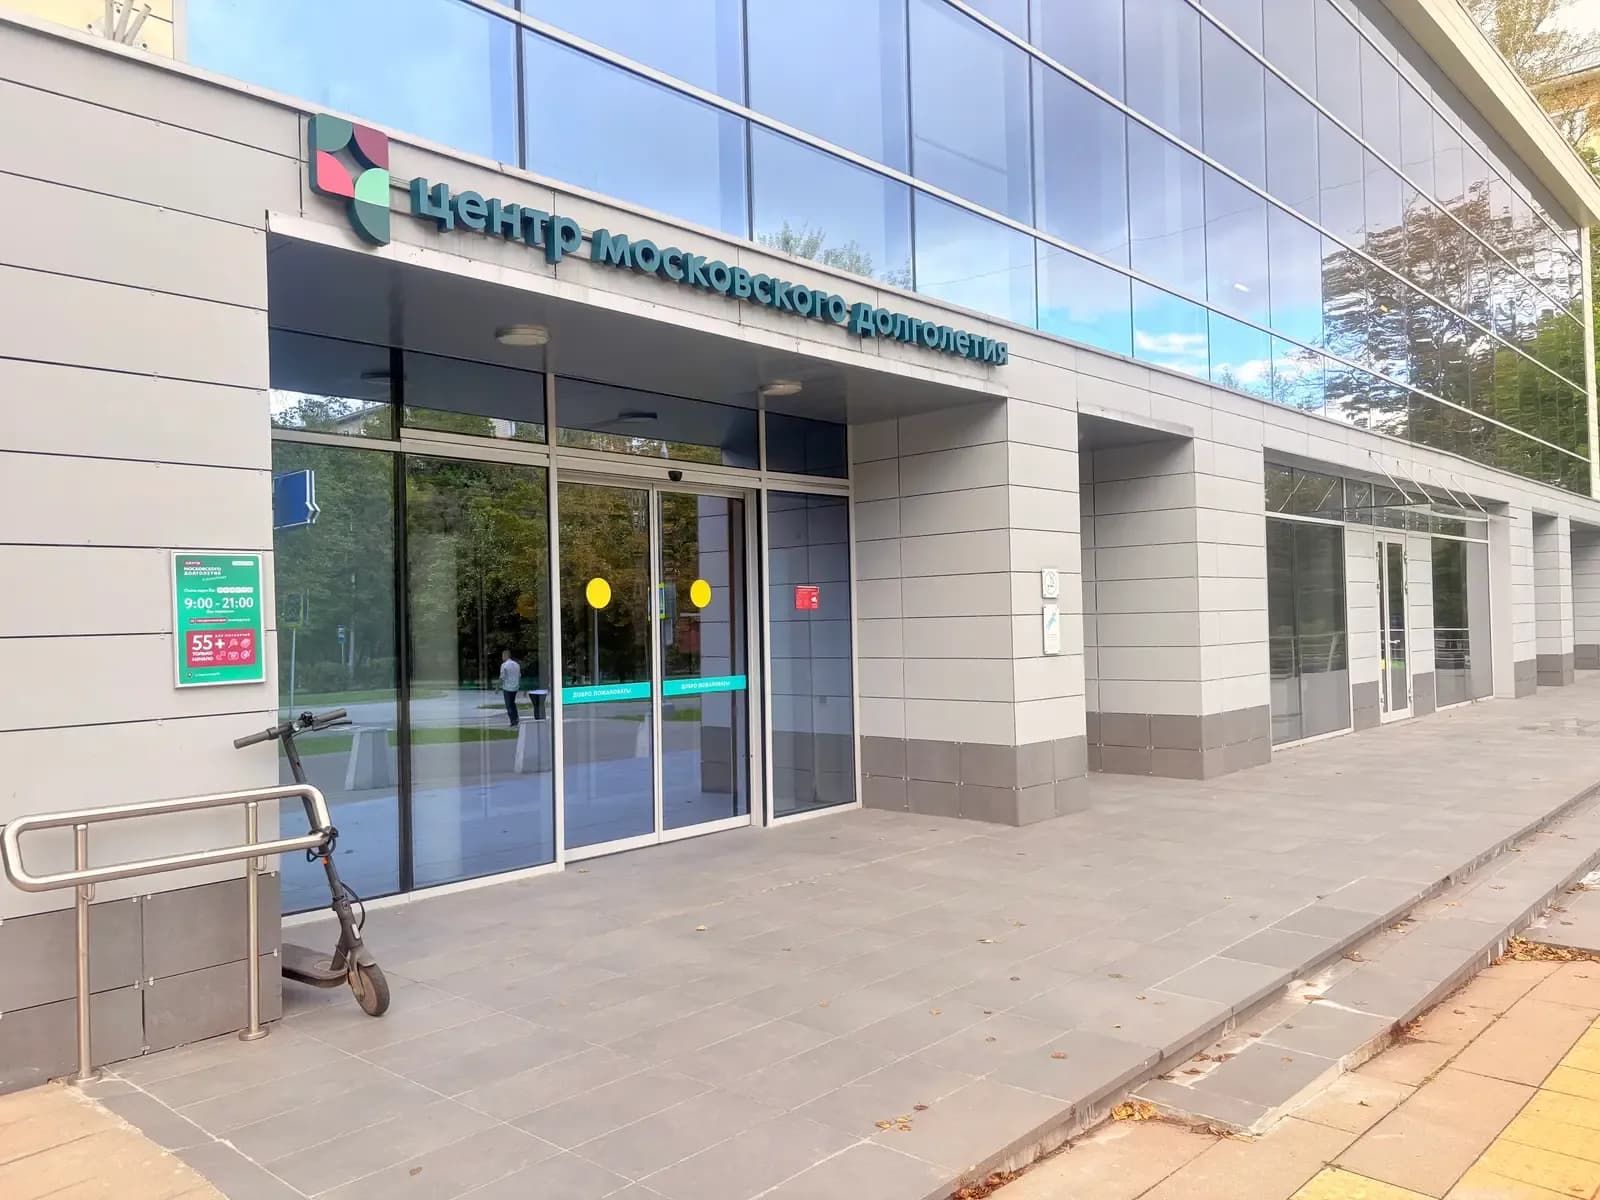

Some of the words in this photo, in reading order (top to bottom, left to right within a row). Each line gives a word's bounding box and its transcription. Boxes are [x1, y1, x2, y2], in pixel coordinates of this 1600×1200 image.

[410, 177, 582, 264] центр
[591, 228, 847, 324] московского
[848, 302, 1009, 366] долголетия
[184, 597, 213, 609] 9:00
[222, 596, 254, 609] 21:00
